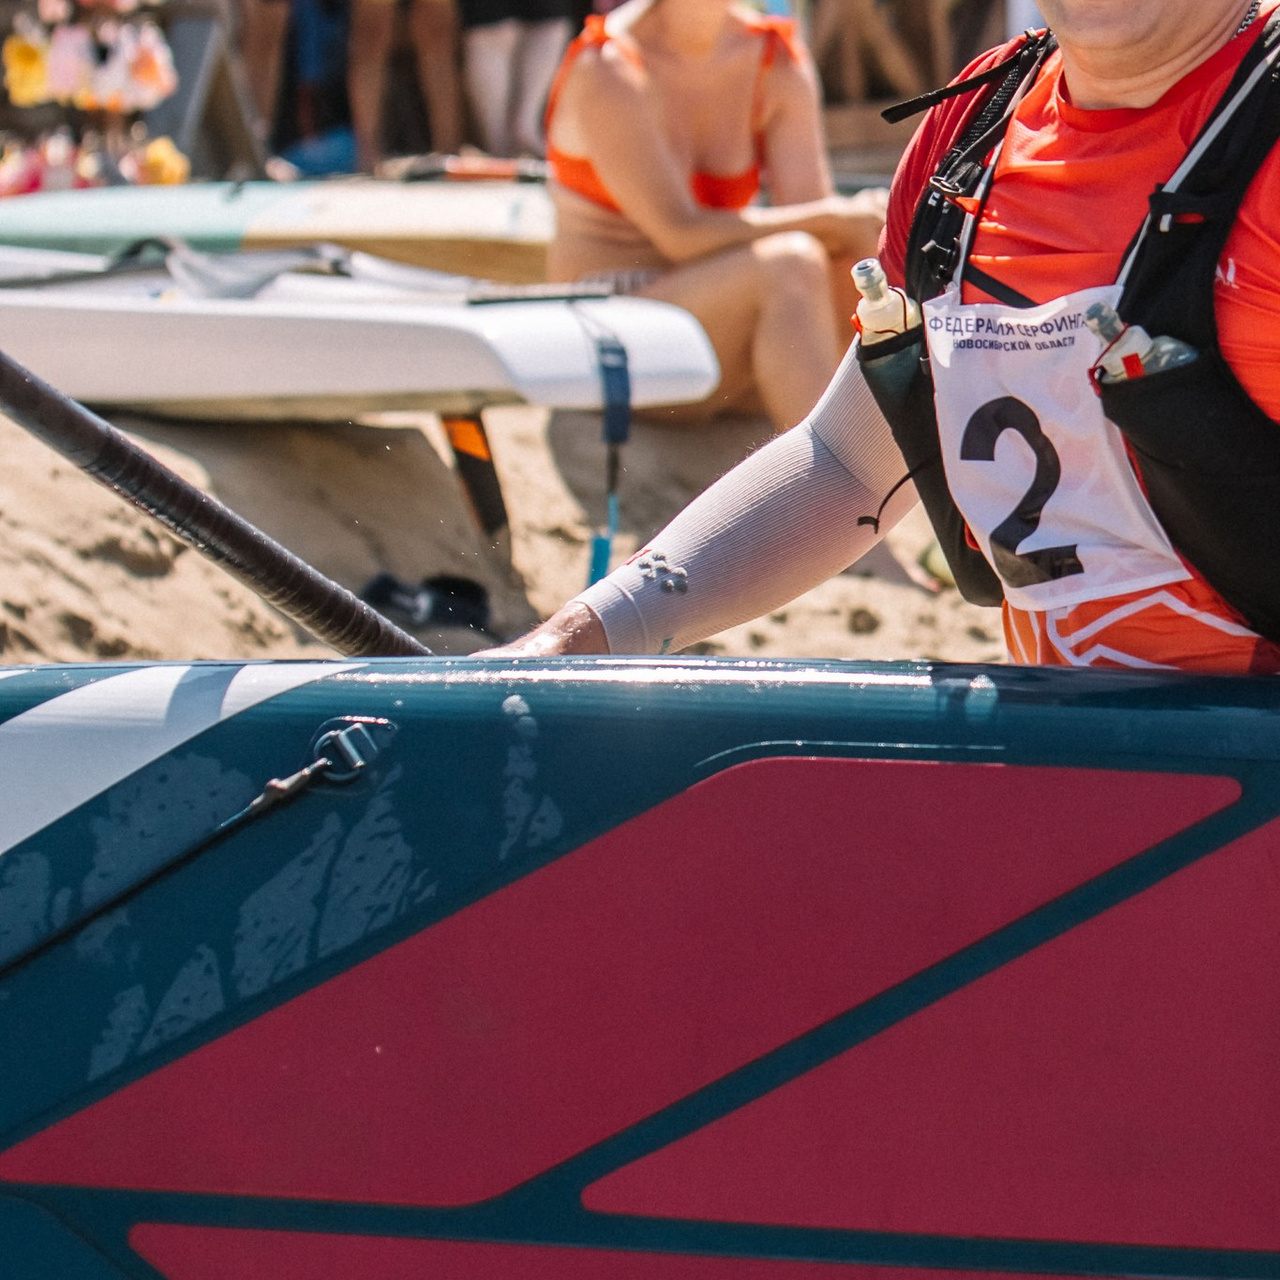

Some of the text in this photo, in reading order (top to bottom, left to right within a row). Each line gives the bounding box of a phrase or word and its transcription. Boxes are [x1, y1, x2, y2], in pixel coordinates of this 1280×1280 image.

[929, 316, 1015, 337] ФЕДЕРАИЯ
[953, 338, 1031, 352] НОВОСИБРСКОЙ
[958, 395, 1085, 588] 2
